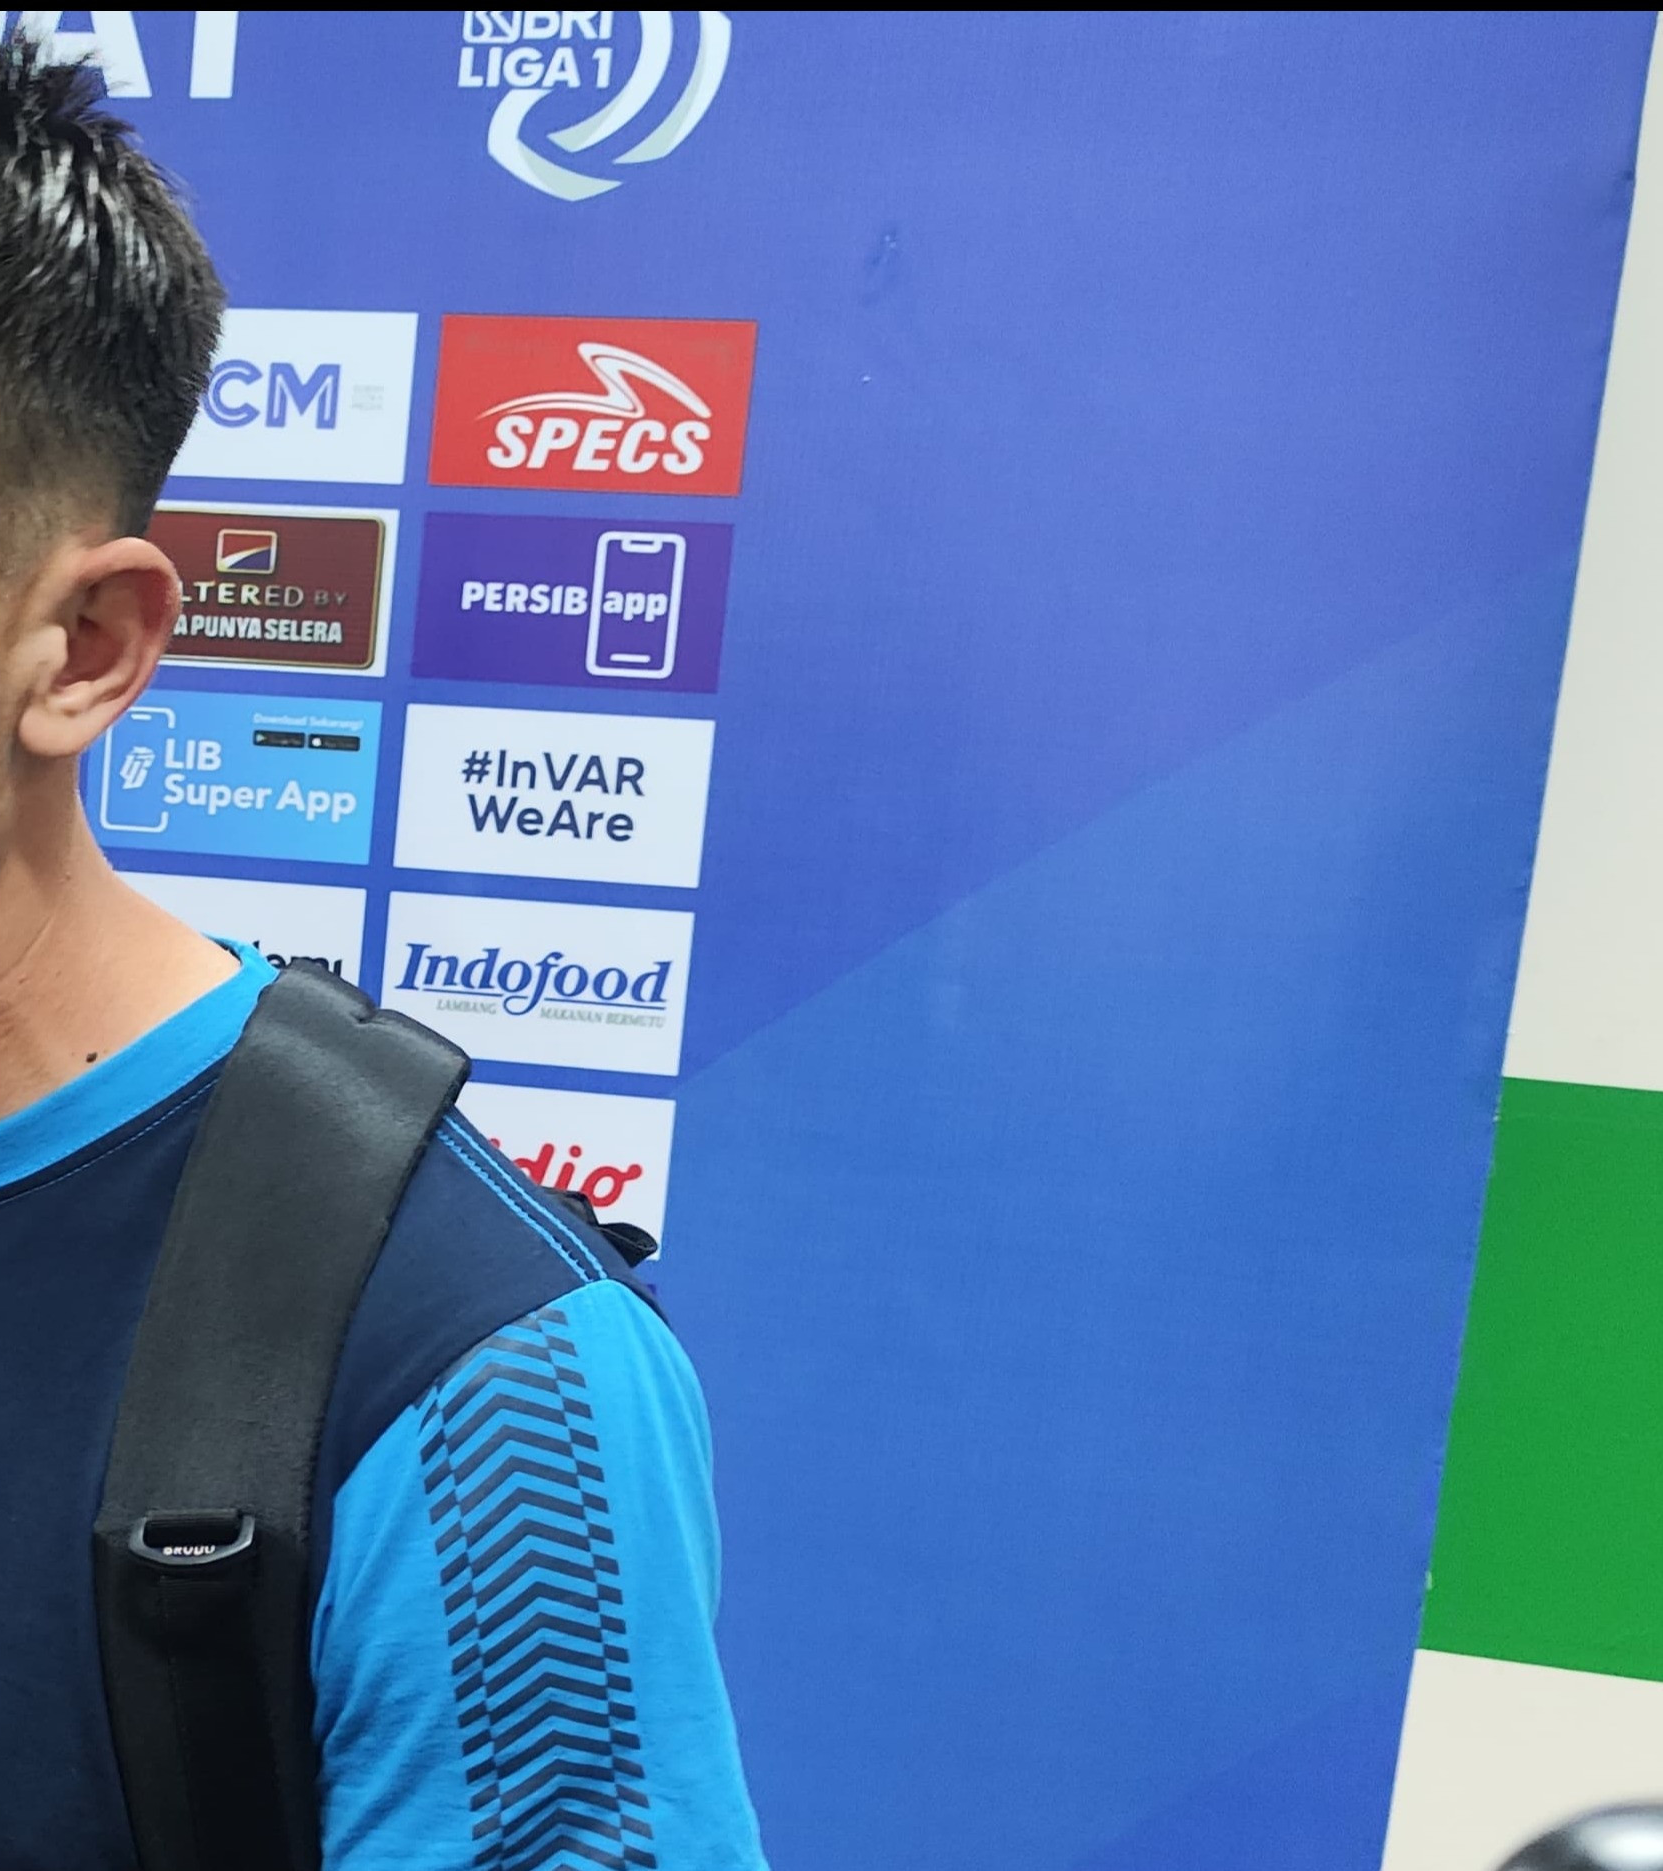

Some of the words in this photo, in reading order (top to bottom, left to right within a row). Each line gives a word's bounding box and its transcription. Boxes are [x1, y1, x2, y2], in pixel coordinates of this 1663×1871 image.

[458, 47, 581, 88] LIGA
[592, 47, 613, 89] 1
[487, 415, 712, 475] SPECS
[461, 581, 588, 616] PERSIB
[602, 588, 669, 623] app
[190, 615, 262, 640] PUNYA
[264, 618, 343, 644] SELERA
[165, 738, 221, 771] LIB
[462, 749, 646, 797] #InVAR
[163, 777, 272, 811] Super
[276, 780, 357, 823] App
[468, 795, 635, 843] WeAre
[397, 943, 673, 1016] Indofood
